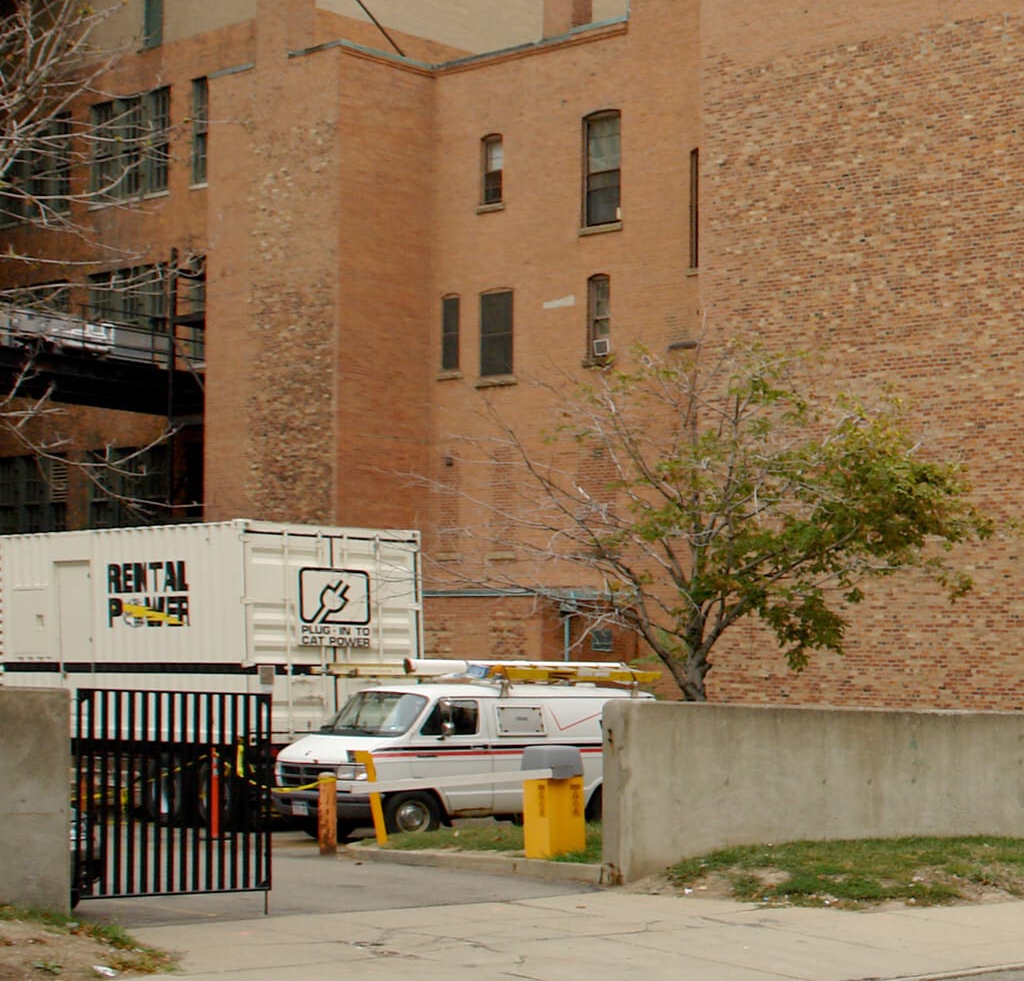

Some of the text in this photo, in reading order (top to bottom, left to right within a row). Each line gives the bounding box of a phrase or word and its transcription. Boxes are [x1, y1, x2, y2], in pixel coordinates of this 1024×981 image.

[107, 561, 189, 593] RENTAL
[108, 596, 191, 628] POWER
[302, 635, 370, 649] CAT POWER
[356, 627, 370, 636] TO
